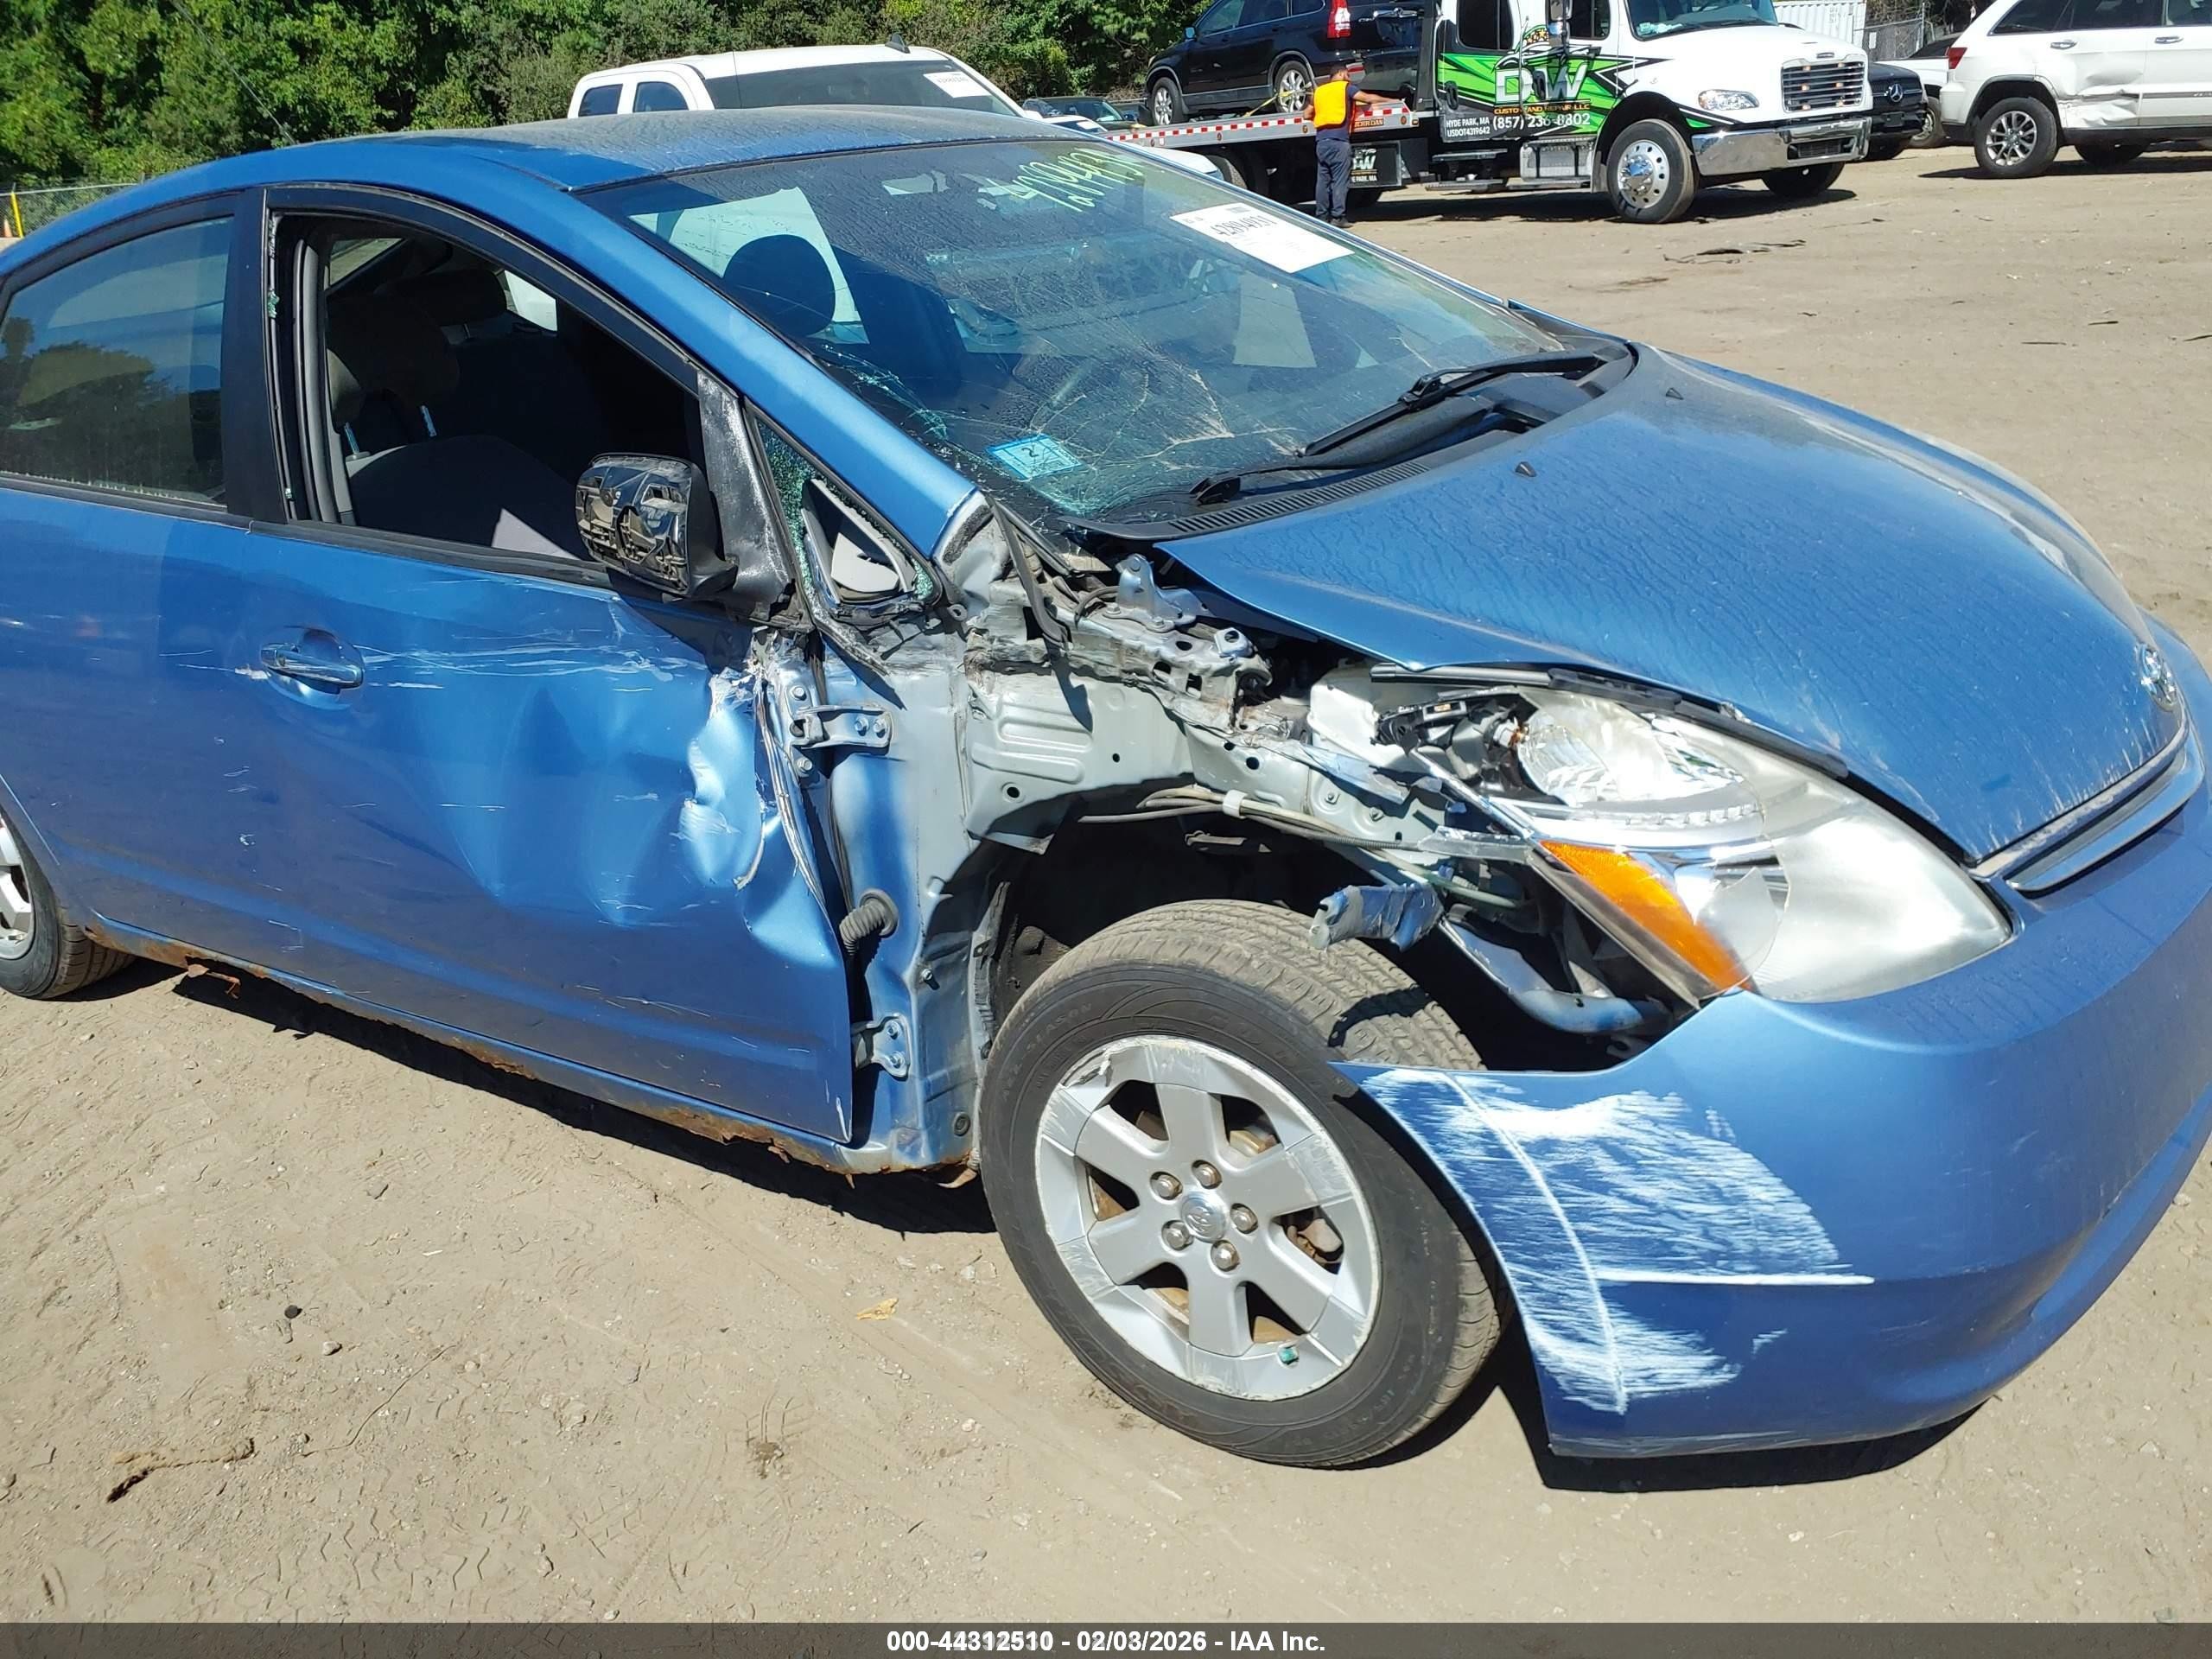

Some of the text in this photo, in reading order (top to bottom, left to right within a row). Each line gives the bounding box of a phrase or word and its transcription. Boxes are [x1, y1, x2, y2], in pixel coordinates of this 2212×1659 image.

[1495, 61, 1590, 103] DW
[1446, 118, 1461, 128] HYDE
[1480, 116, 1491, 125] MA
[1493, 115, 1524, 130] (857)
